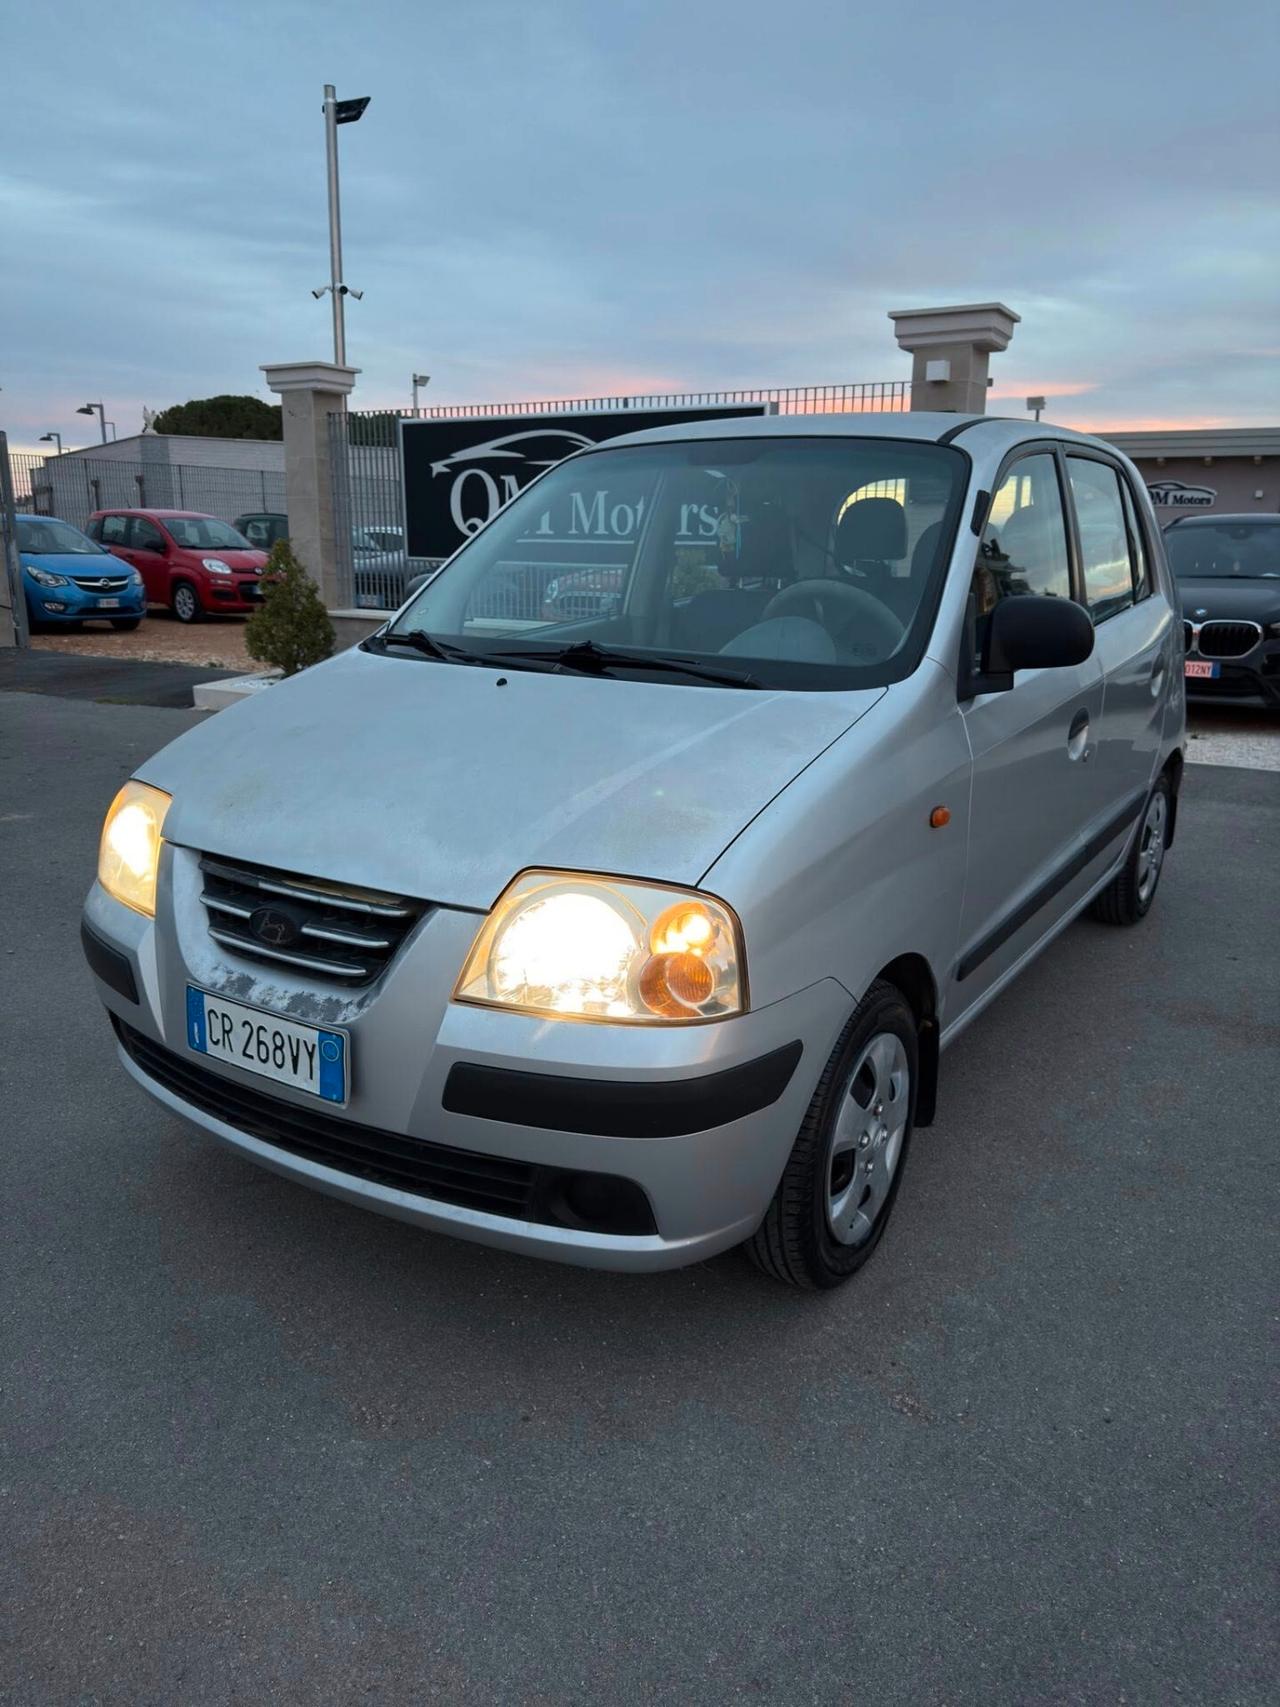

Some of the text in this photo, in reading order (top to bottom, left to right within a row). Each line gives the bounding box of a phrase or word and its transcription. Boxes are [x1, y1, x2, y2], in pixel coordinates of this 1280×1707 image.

[568, 490, 720, 536] Motrs
[1172, 494, 1211, 505] Motors
[207, 1009, 316, 1080] CR 268VY
